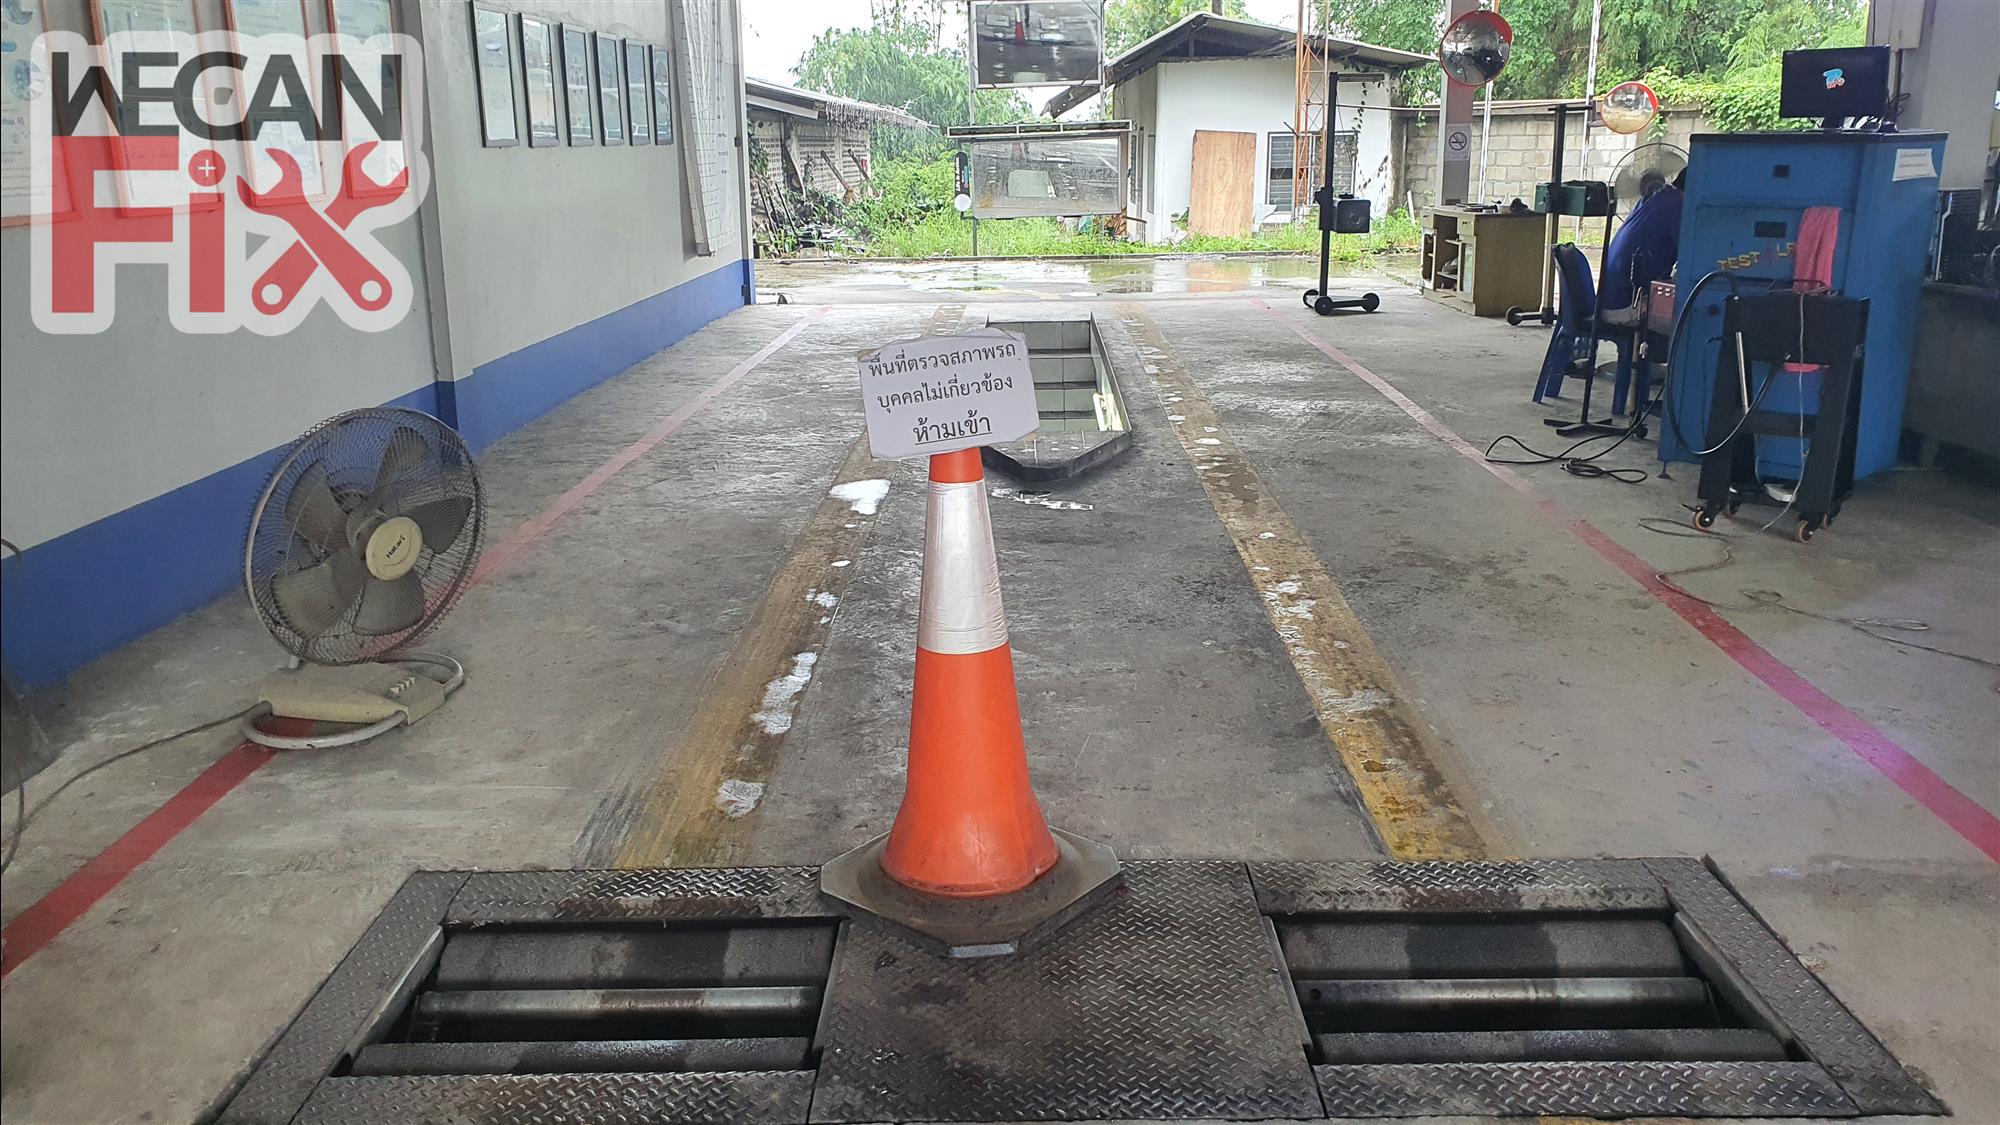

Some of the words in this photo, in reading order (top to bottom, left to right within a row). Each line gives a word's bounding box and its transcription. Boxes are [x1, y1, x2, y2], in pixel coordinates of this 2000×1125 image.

[1717, 251, 1761, 270] TEST
[868, 343, 1016, 377] พื้นที่ตรวจสภาพรถ
[877, 372, 1013, 414] บุคคลไม่เกี่ยวข้อง
[912, 409, 992, 443] ห้ามเข้า
